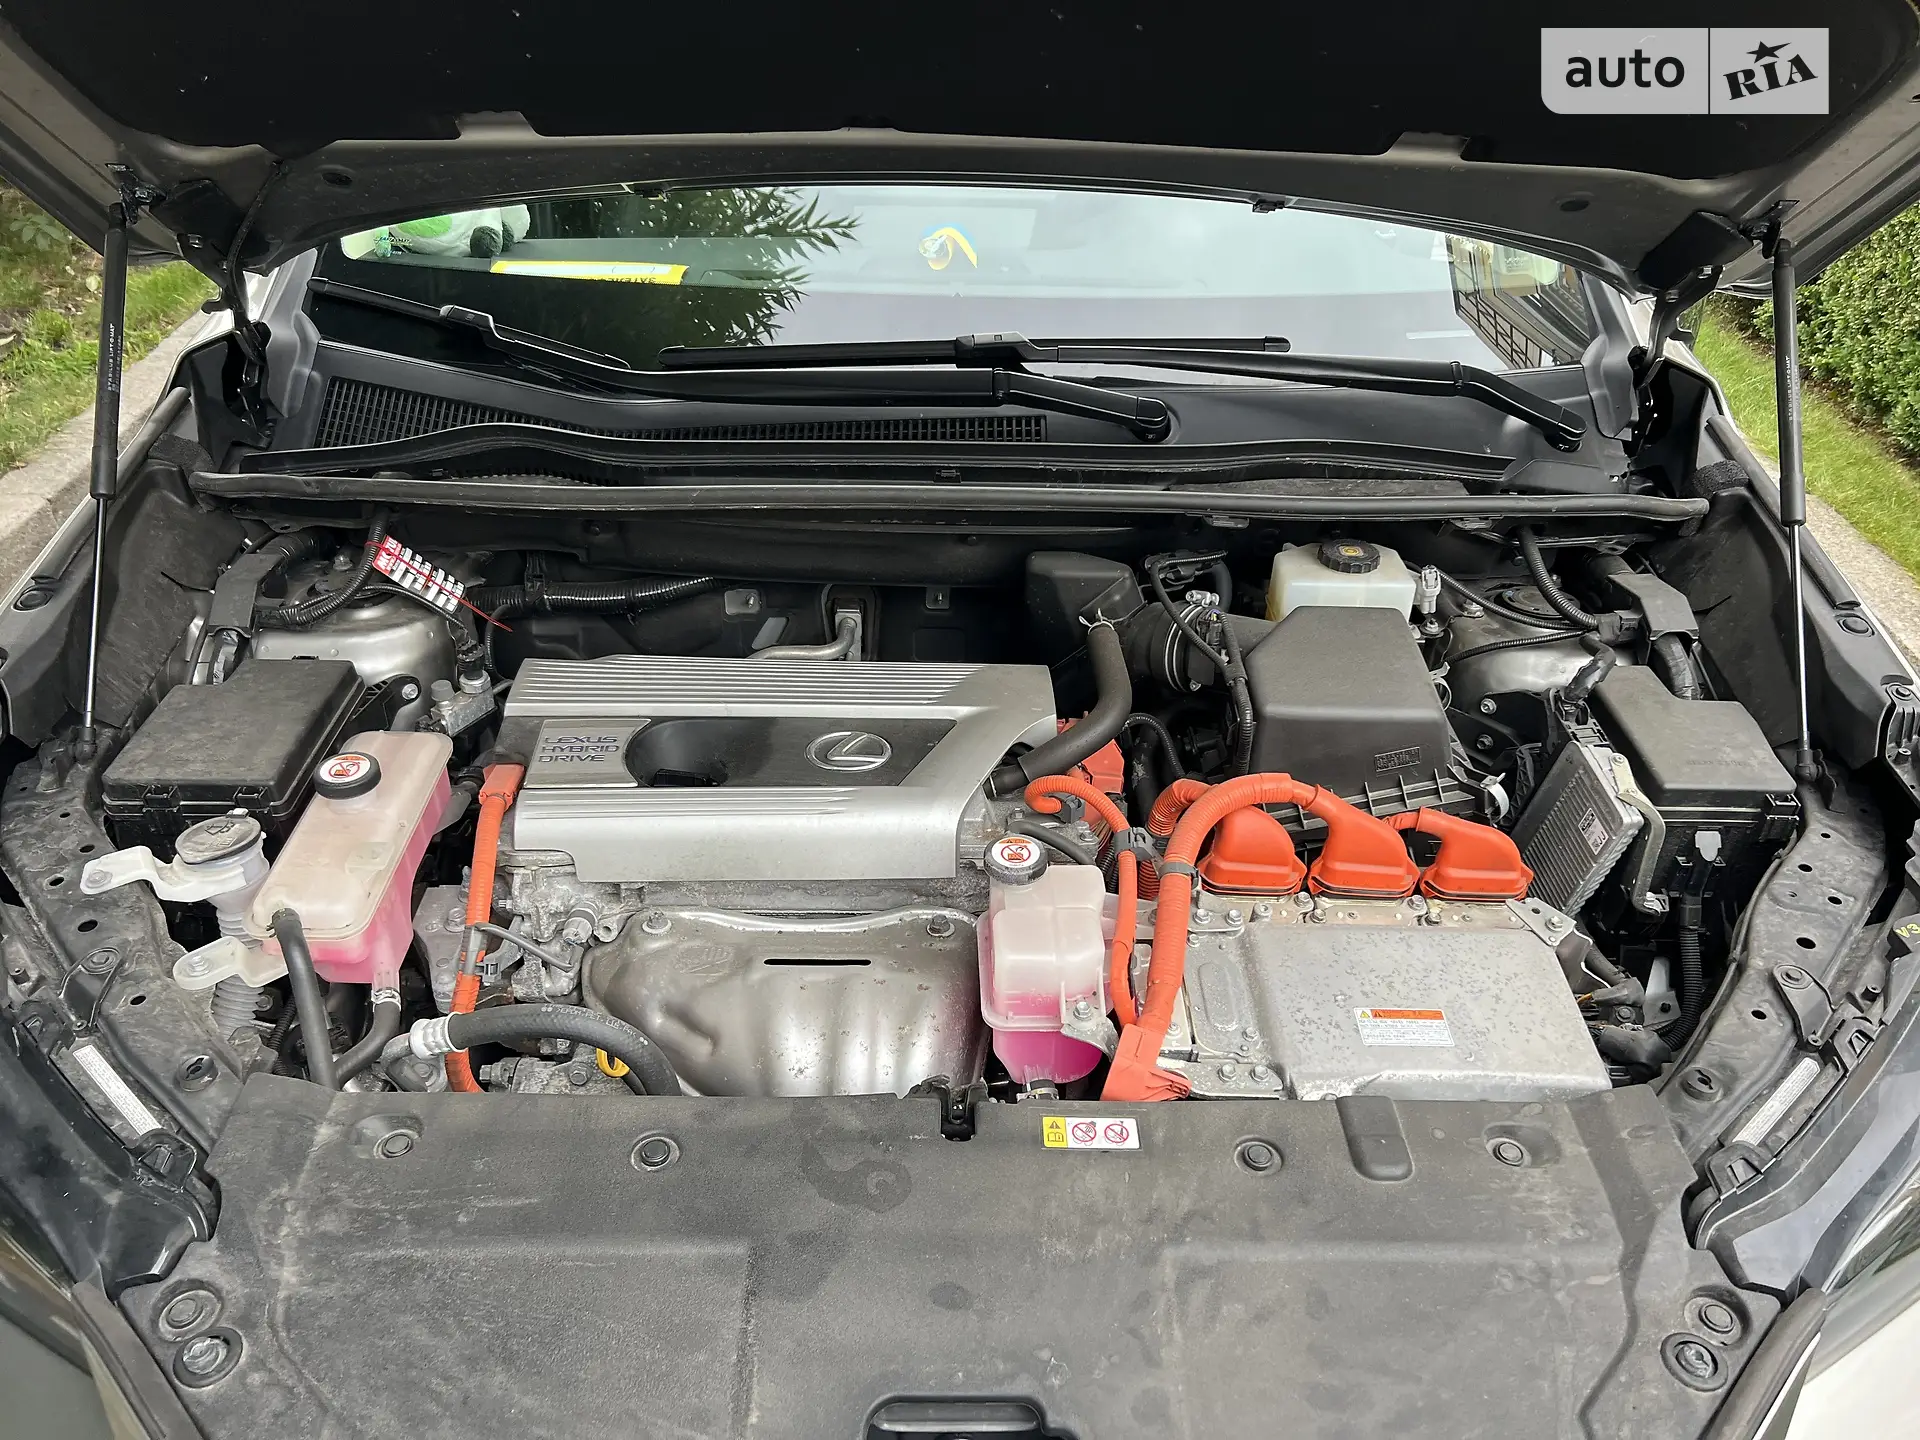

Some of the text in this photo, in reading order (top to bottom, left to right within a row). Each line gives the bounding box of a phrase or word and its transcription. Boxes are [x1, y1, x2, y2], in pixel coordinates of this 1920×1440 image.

[545, 735, 618, 744] LEXUS
[541, 744, 620, 753] HYBRID
[538, 754, 606, 763] DRIVE
